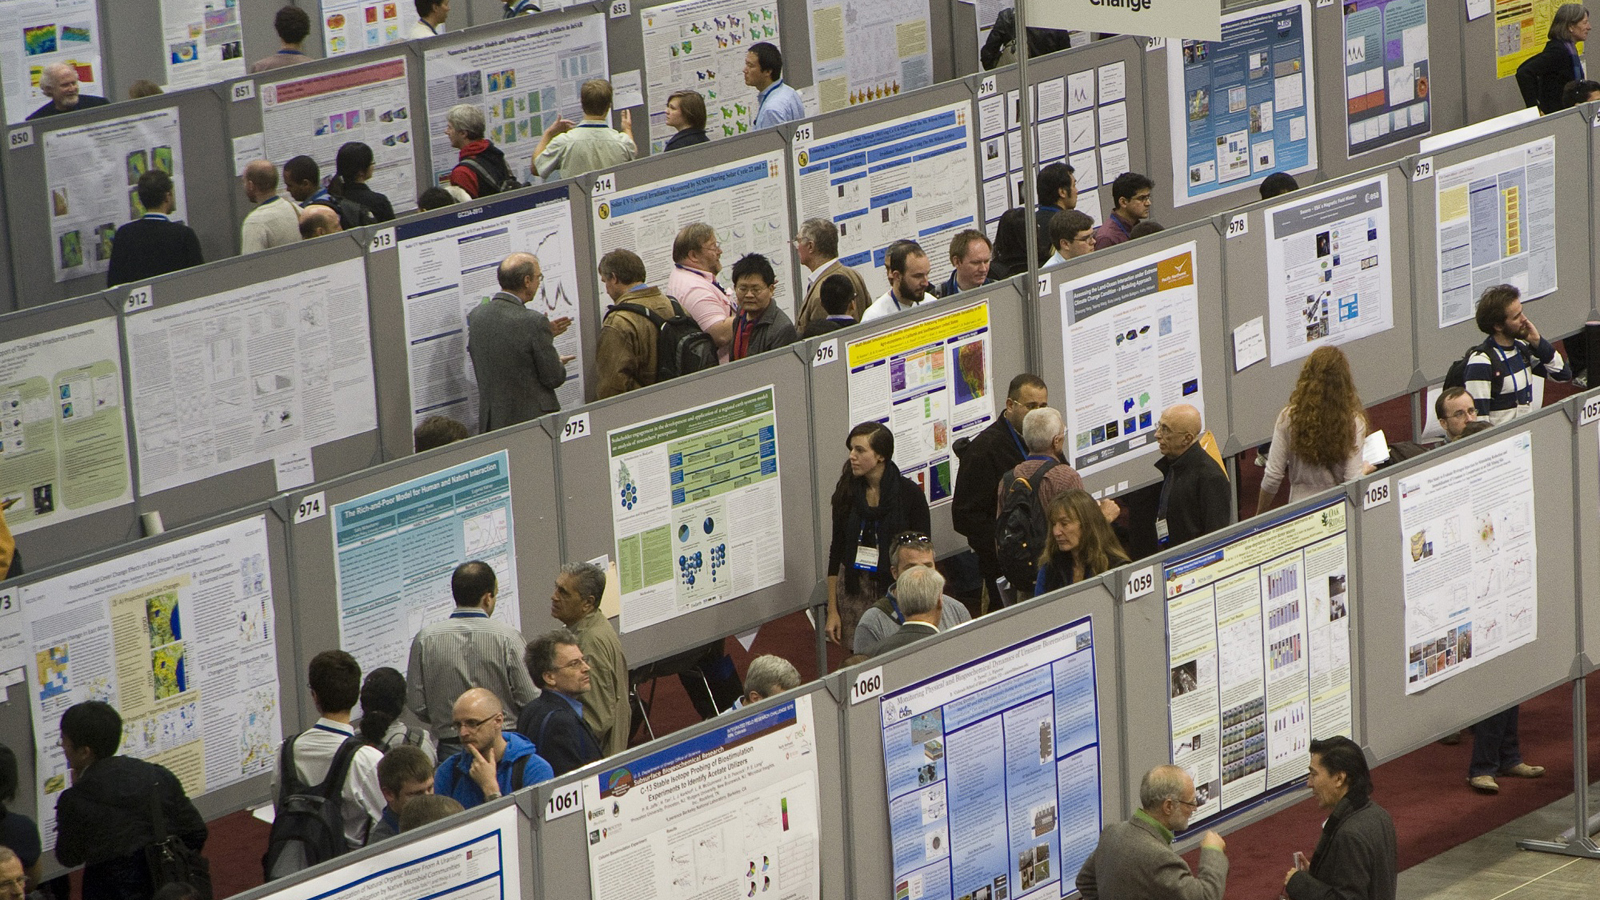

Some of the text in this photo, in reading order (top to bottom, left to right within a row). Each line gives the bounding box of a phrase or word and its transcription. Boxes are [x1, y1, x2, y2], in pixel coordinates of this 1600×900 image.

[612, 3, 626, 14] 853
[1148, 36, 1160, 47] 917
[235, 85, 249, 97] 851
[980, 80, 992, 93] 916
[11, 132, 28, 144] 850
[795, 128, 809, 141] 915
[1415, 162, 1429, 176] 979
[595, 178, 610, 191] 914
[1229, 219, 1243, 233] 978
[373, 234, 390, 247] 913
[128, 292, 146, 306] 912
[1074, 298, 1086, 306] Climate
[816, 345, 833, 361] 976
[564, 419, 584, 436] 975
[345, 510, 355, 518] The
[356, 497, 394, 515] Rich-and-Poor
[395, 491, 412, 502] Model
[421, 482, 440, 493] Human
[451, 473, 468, 483] Nature
[469, 464, 496, 477] Interaction
[1365, 484, 1388, 503] 1058
[298, 499, 319, 517] 974
[112, 569, 127, 578] Change
[157, 556, 171, 564] African
[200, 543, 215, 551] Climate
[216, 538, 230, 547] Change
[1127, 573, 1152, 594] 1059
[897, 688, 924, 705] Monitoring
[925, 681, 944, 694] Physical
[945, 677, 954, 686] and
[955, 663, 990, 682] Biogeochemical
[992, 654, 1014, 667] Dynamics
[1020, 643, 1041, 657] Uranium
[1042, 630, 1076, 648] Bioremediation
[852, 675, 880, 697] 1060
[634, 746, 724, 785] Subsurface Biogeochemical Research
[640, 783, 652, 794] C-13
[653, 778, 669, 789] Stable
[670, 771, 689, 783] Isotope
[690, 763, 710, 776] Probing
[717, 746, 753, 765] Biostimulation
[642, 766, 660, 775] Department
[648, 784, 680, 802] Experiments
[687, 774, 706, 786] Identify
[708, 766, 727, 778] Acetate
[728, 759, 748, 771] Utilizers
[548, 790, 578, 813] 1061
[365, 880, 382, 891] Natural
[383, 873, 402, 884] Organic
[404, 867, 420, 877] Matter
[421, 862, 435, 870] From
[386, 882, 402, 892] Native
[403, 874, 427, 886] Microbial
[427, 864, 460, 877] Communities
